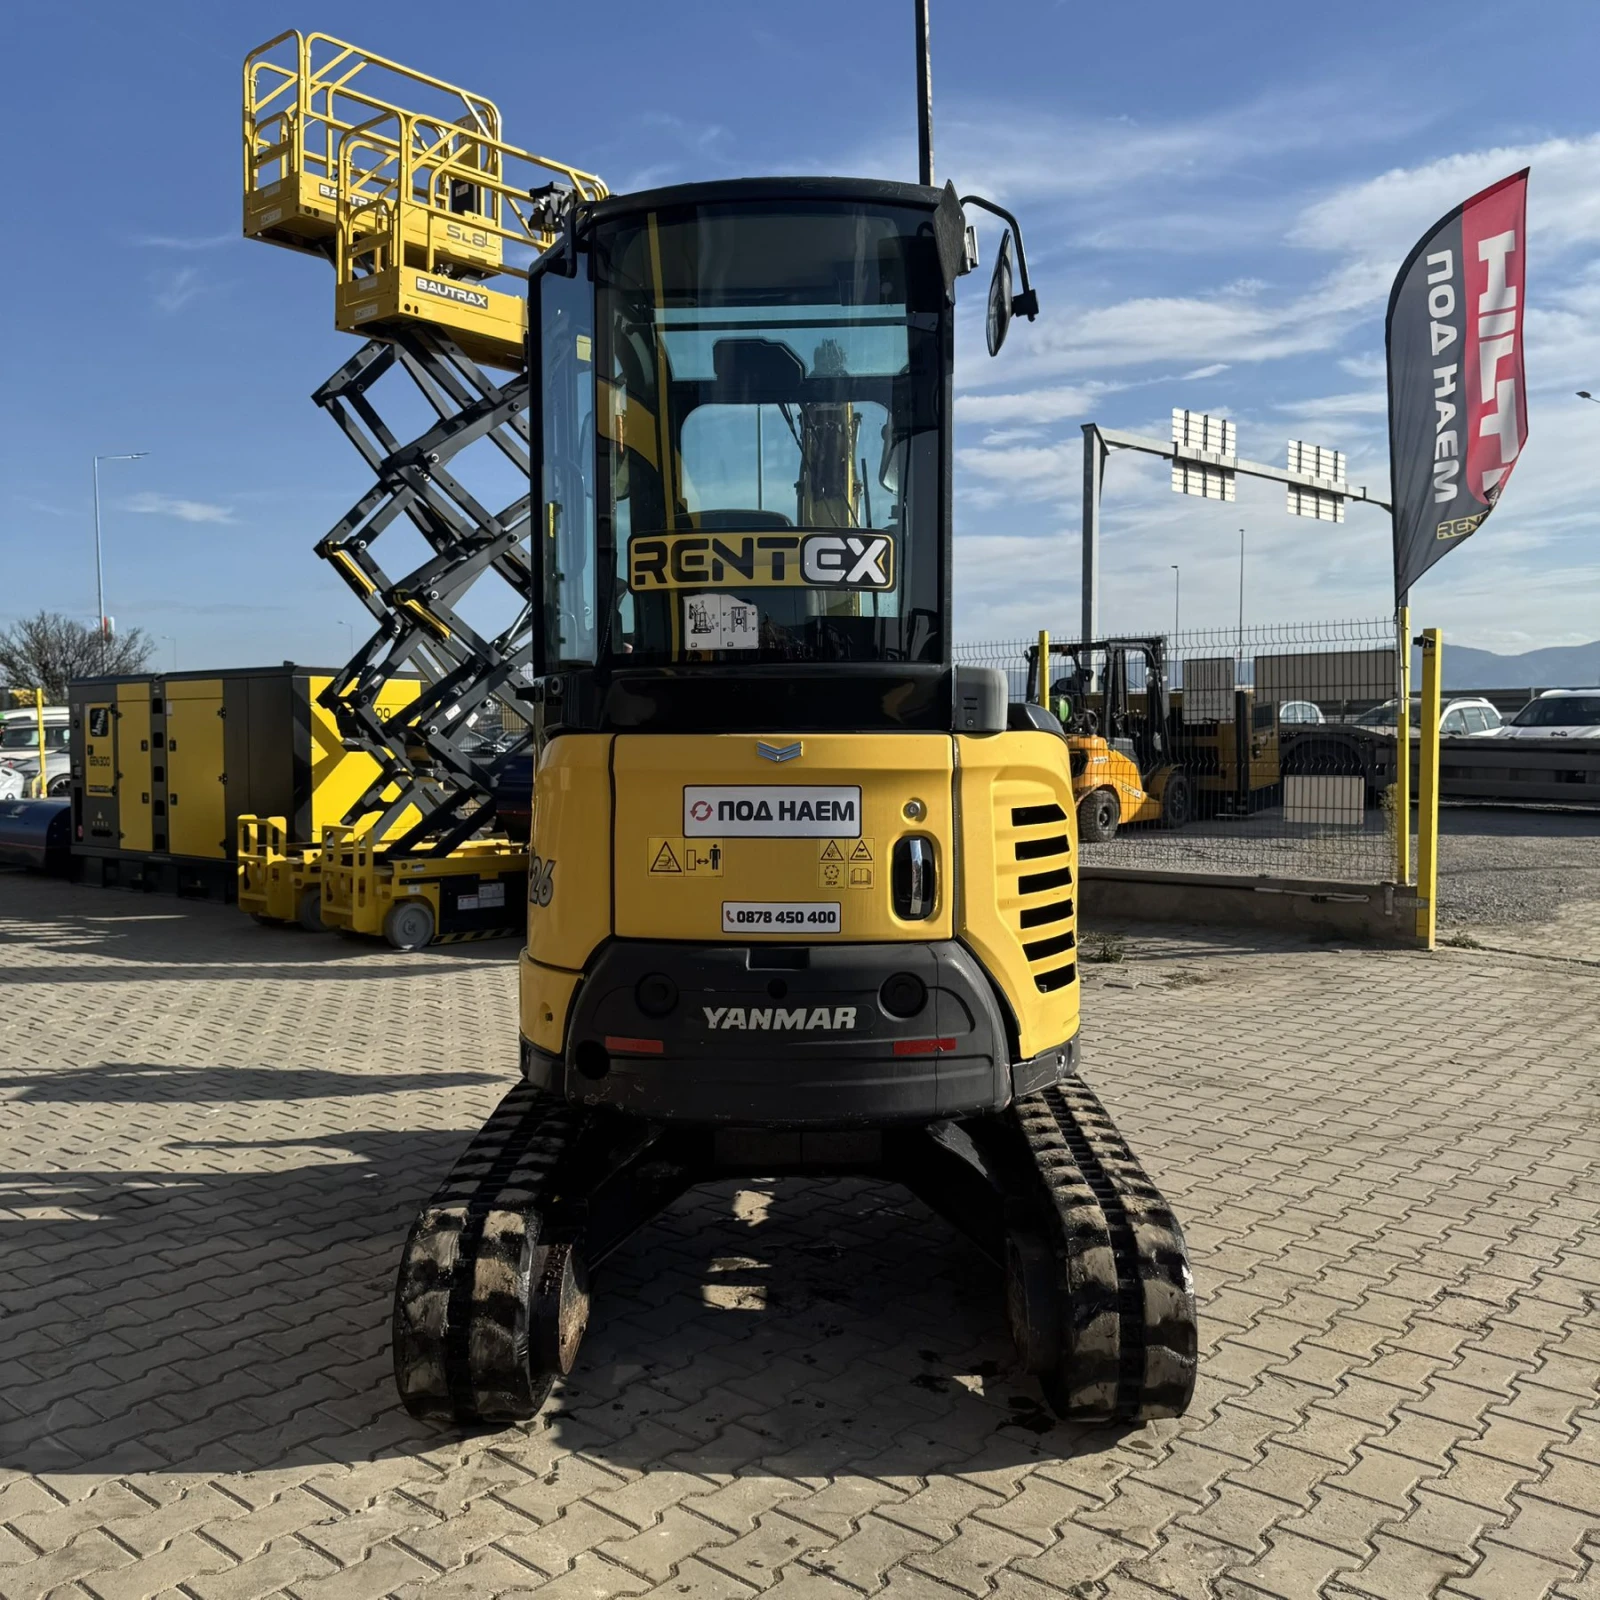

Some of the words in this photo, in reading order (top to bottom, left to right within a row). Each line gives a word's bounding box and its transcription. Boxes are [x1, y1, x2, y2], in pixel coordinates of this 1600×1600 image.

[447, 224, 486, 248] SL8
[416, 277, 487, 307] BAUTRAX
[1427, 249, 1457, 356] ПОД
[1433, 363, 1459, 503] НАЕМ
[634, 537, 887, 586] RENTEX
[718, 800, 773, 821] ПОД
[779, 800, 855, 821] НАЕМ
[736, 911, 773, 924] 0878
[775, 911, 804, 924] 450
[807, 911, 836, 924] 400
[703, 1007, 857, 1030] YANMAR
